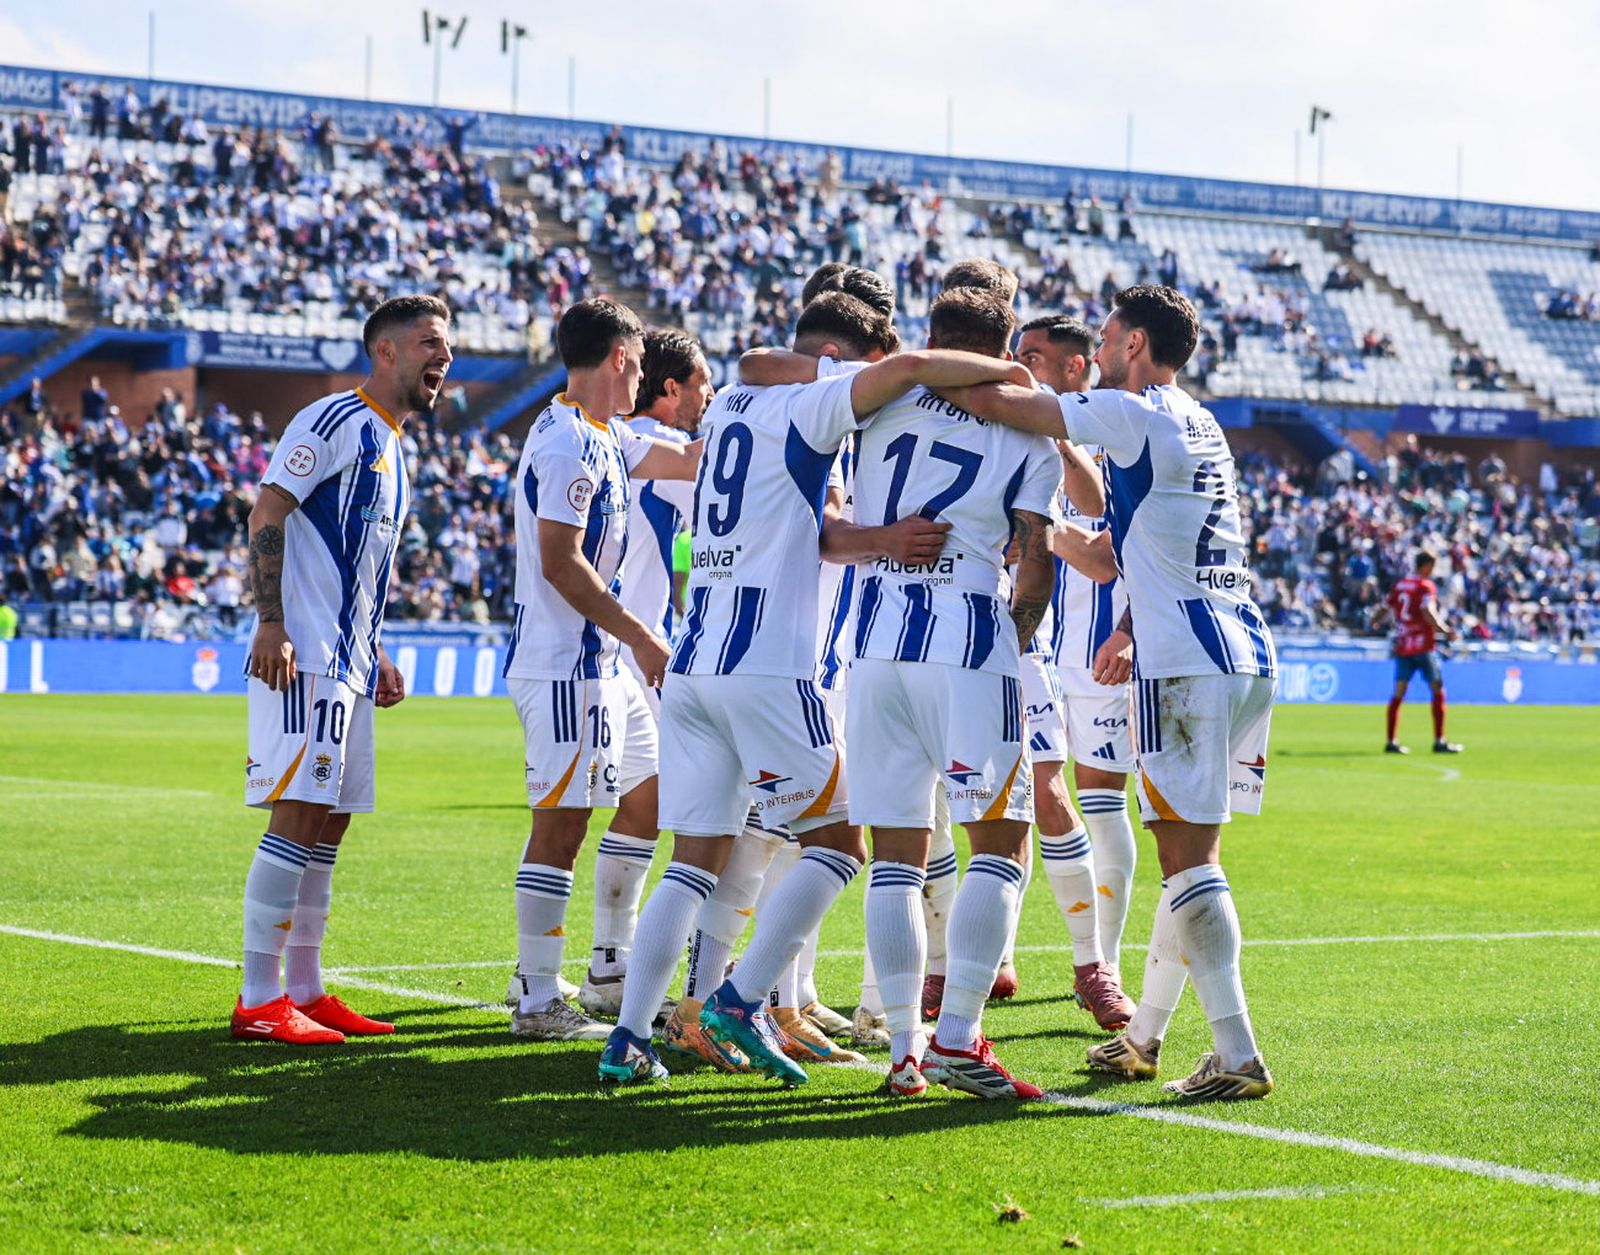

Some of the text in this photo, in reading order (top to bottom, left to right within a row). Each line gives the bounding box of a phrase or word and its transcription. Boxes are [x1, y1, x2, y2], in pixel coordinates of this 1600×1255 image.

[883, 432, 984, 526] 17
[691, 544, 735, 568] uelva
[313, 698, 346, 745] 10
[587, 704, 612, 749] 16
[766, 789, 816, 808] INTERBUS
